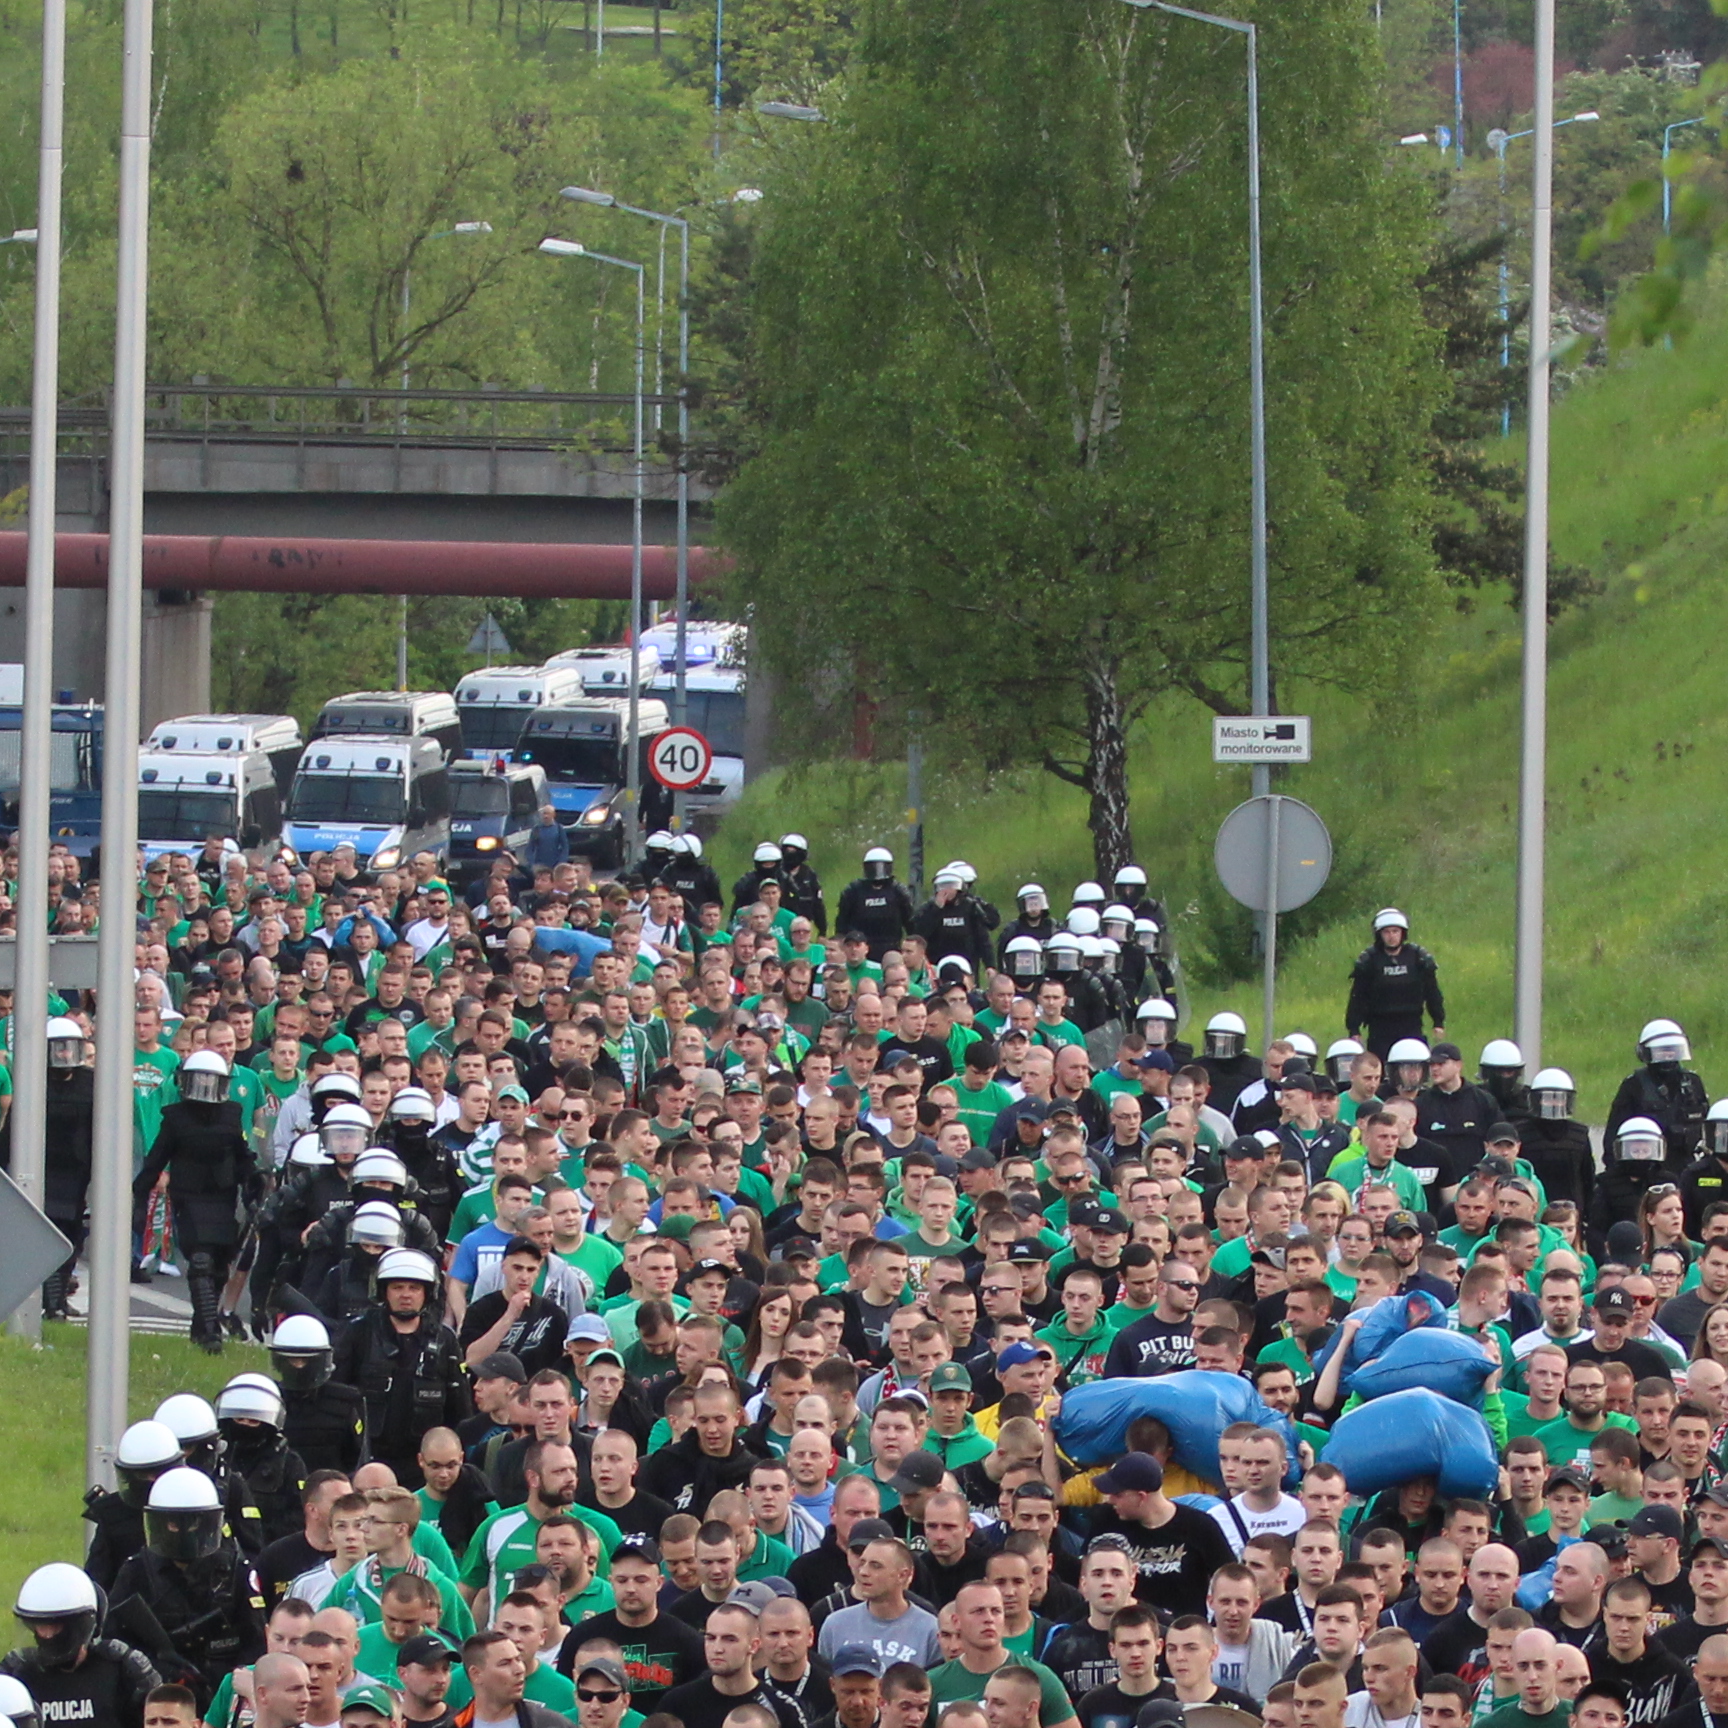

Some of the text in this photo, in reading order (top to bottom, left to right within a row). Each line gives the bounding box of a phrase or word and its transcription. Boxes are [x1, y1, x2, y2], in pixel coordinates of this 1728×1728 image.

[1220, 727, 1259, 738] Miasto
[1220, 744, 1303, 754] monitorowane
[659, 744, 699, 773] 40
[42, 1699, 96, 1721] POLICJA
